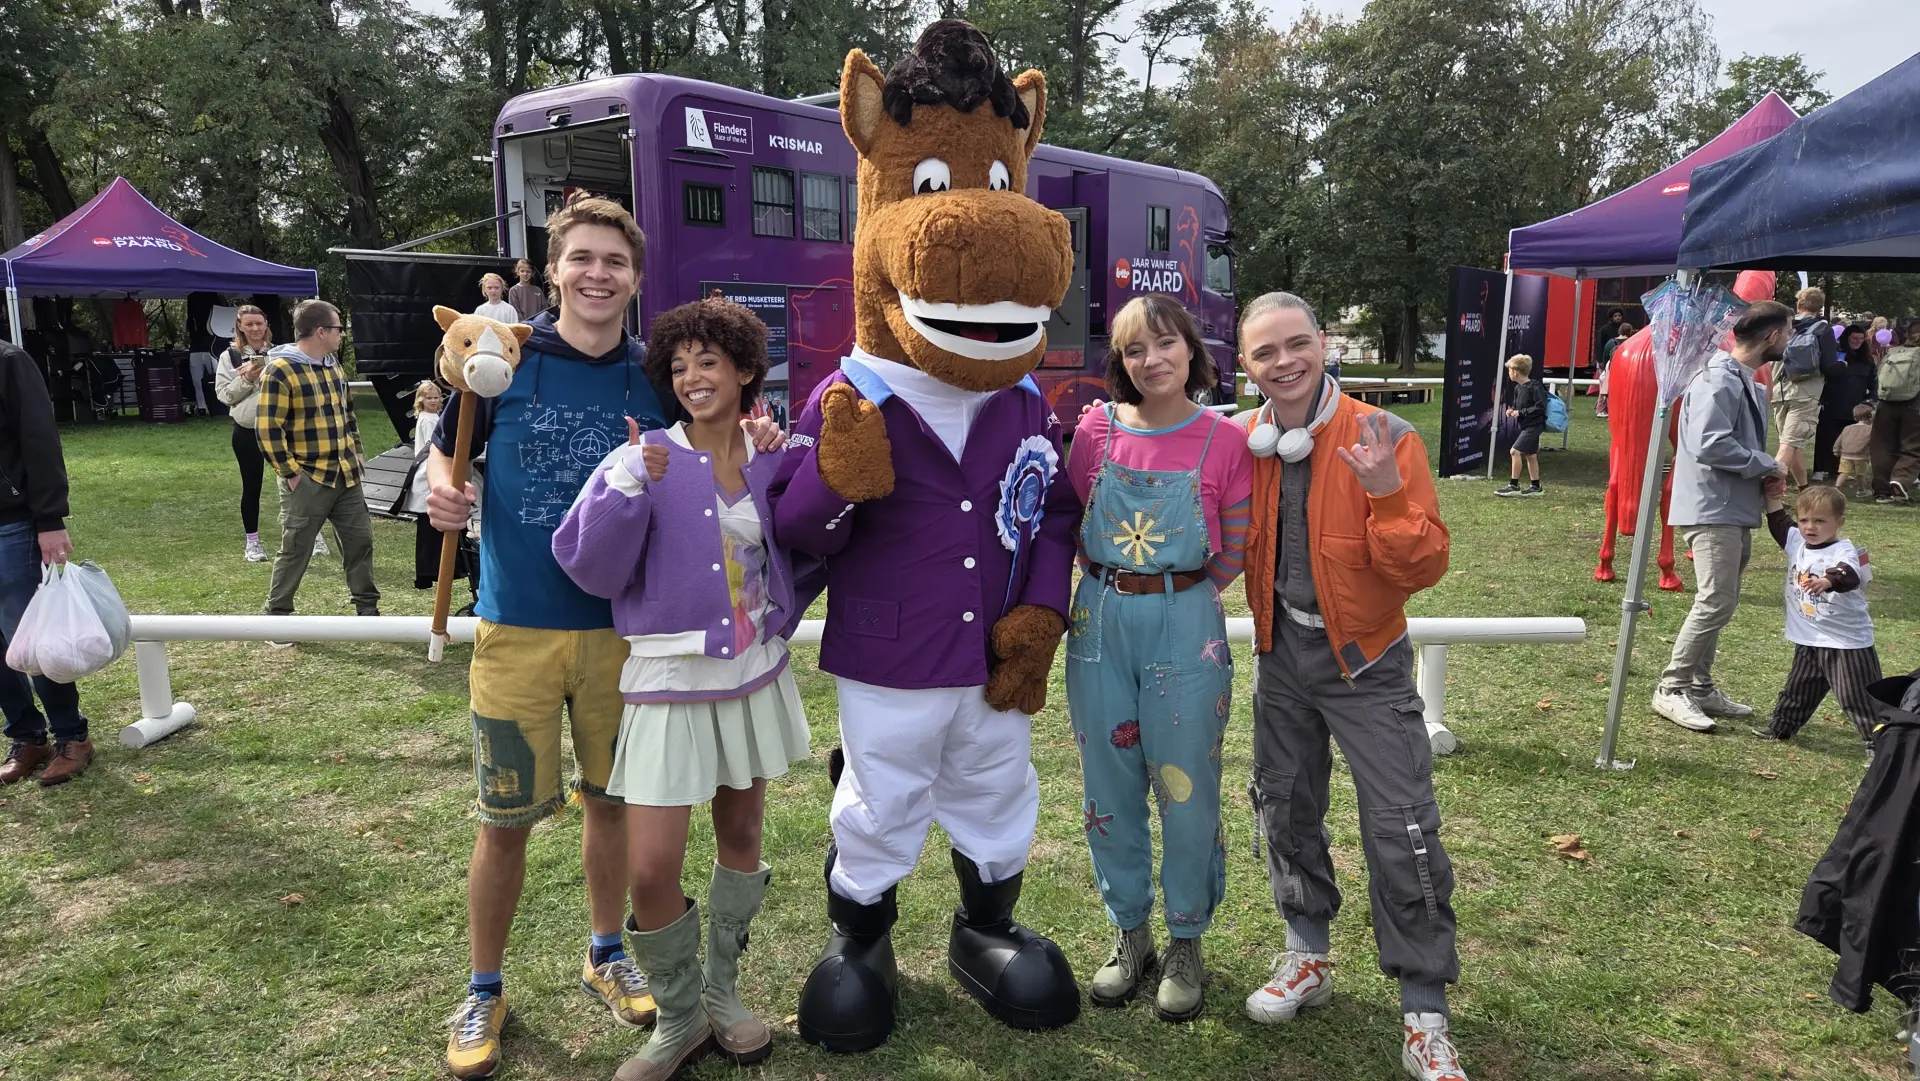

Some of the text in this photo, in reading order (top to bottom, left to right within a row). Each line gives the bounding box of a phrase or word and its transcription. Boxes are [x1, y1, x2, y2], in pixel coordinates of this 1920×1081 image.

[713, 122, 747, 137] Flanders
[714, 133, 726, 141] State
[769, 134, 823, 155] KRISMAR
[114, 240, 183, 251] PAARD
[1131, 257, 1178, 270] JAAR VAN HET
[1132, 269, 1183, 293] PAARD
[748, 296, 785, 304] MUSKETEERS
[1465, 319, 1481, 332] PAARD
[1508, 315, 1530, 330] ELCOME
[791, 433, 815, 448] GINES
